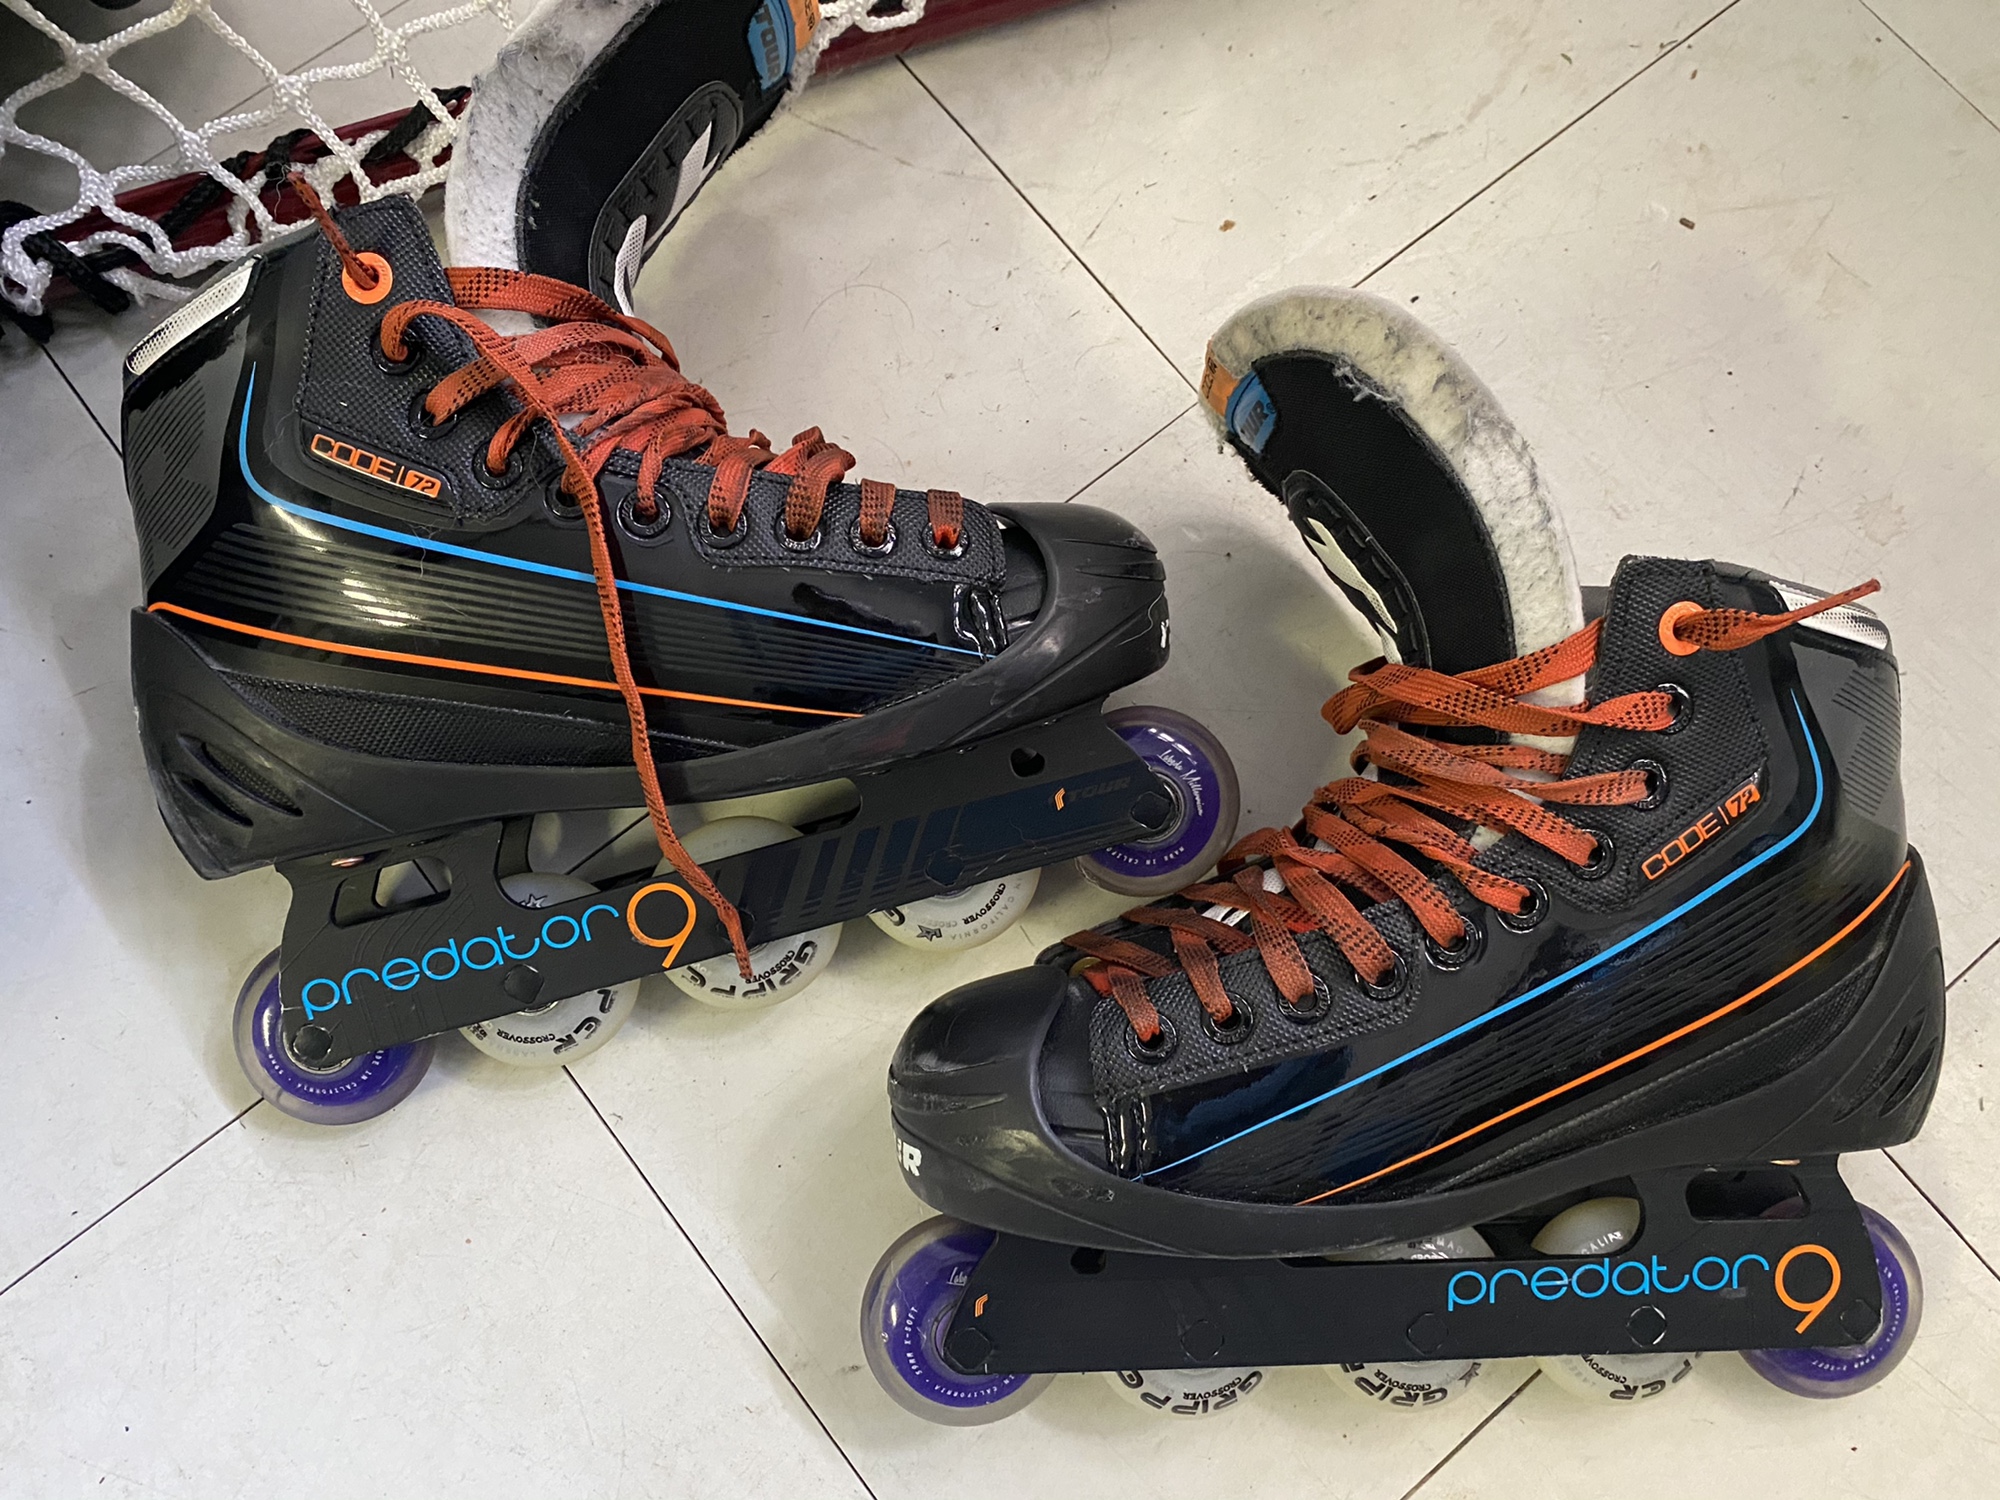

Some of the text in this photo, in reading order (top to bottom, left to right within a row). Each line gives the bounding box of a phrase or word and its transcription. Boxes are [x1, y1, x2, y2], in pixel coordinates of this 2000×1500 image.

[755, 3, 781, 81] TOUR
[311, 434, 439, 496] CODE 72
[1164, 846, 1185, 862] MADE
[1641, 811, 1722, 880] CODE
[1145, 857, 1156, 866] IN
[962, 883, 1006, 925] CROSSOVER
[301, 882, 697, 1021] predator 9
[745, 950, 796, 985] CROSSOVER
[496, 1028, 556, 1044] CROSSOVER
[361, 1069, 372, 1081] IN
[296, 1081, 358, 1095] CALIFORNIA
[1448, 1243, 1841, 1334] predator 9
[906, 1352, 923, 1376] 59MM
[934, 1384, 998, 1399] CALIFORNIA
[1183, 1377, 1243, 1400] CROSSOVER
[1374, 1369, 1432, 1392] CROSSOVER
